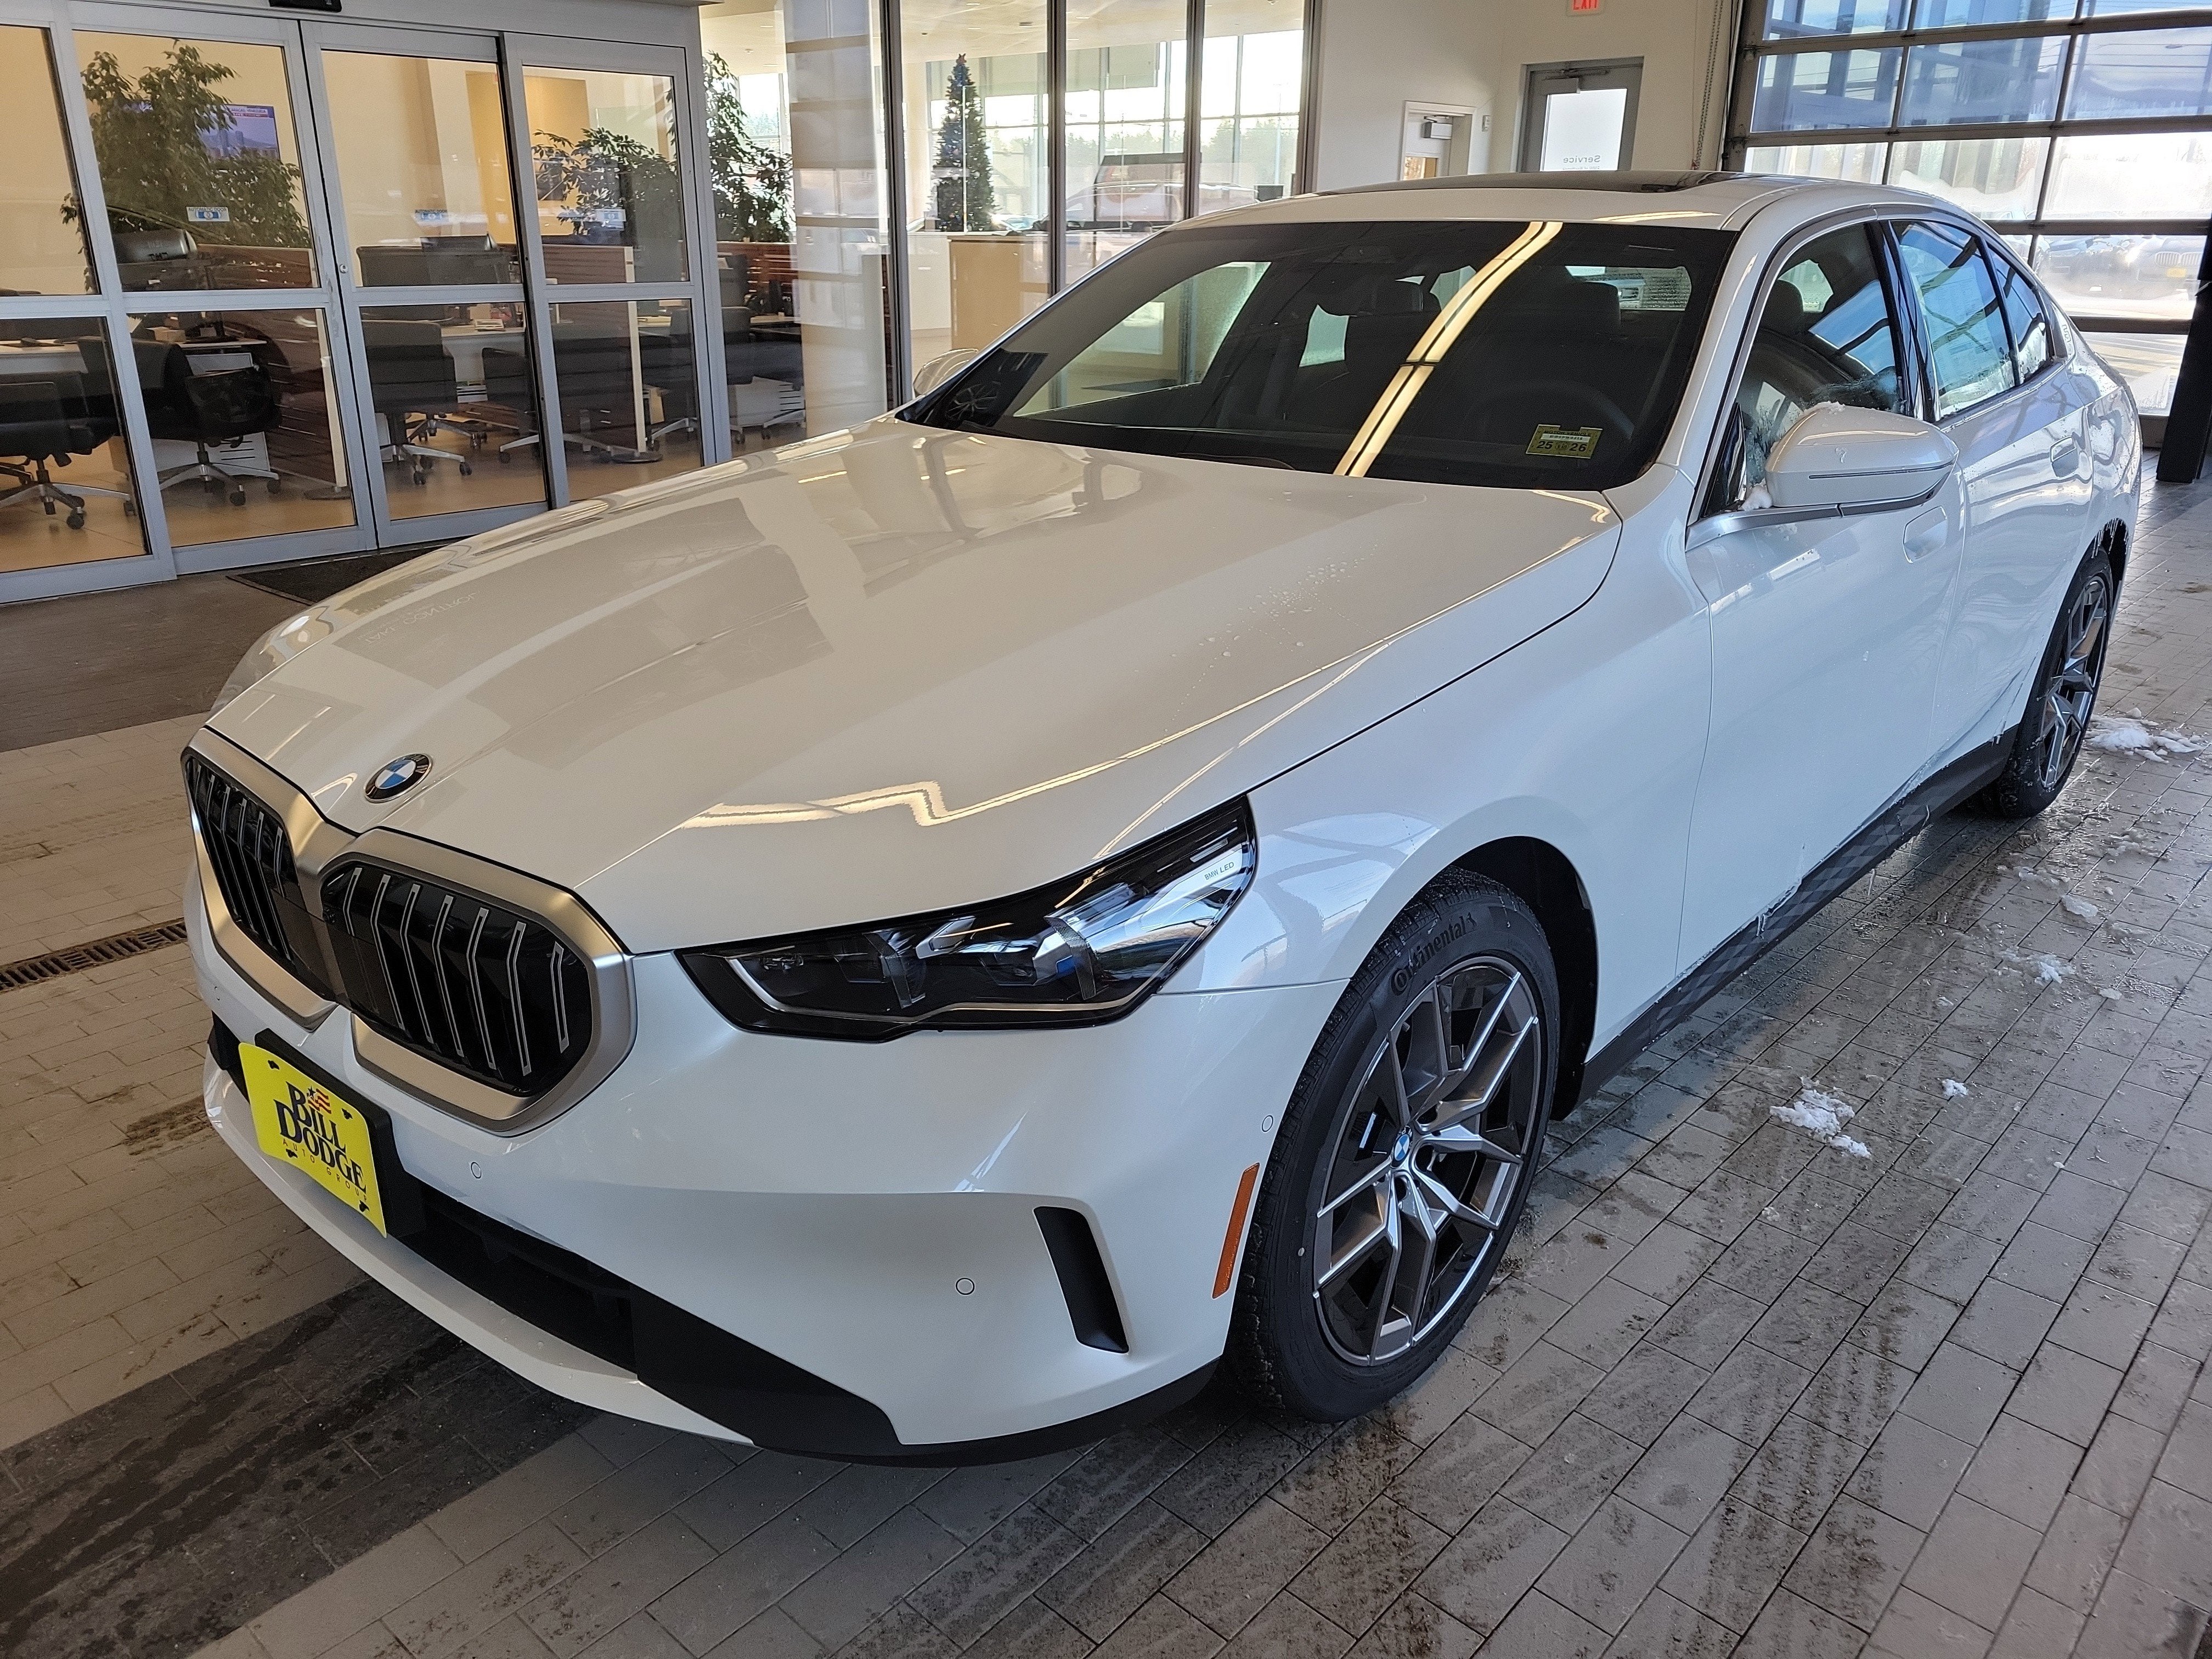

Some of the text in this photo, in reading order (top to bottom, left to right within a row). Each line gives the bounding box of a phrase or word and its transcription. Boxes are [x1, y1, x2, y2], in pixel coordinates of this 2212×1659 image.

[1537, 441, 1553, 449] 25
[1569, 443, 1587, 452] 26
[1204, 862, 1234, 880] BMW LED
[273, 1099, 366, 1194] DODGE
[286, 1081, 346, 1153] BILL
[283, 1139, 368, 1202] AUTO GROUP
